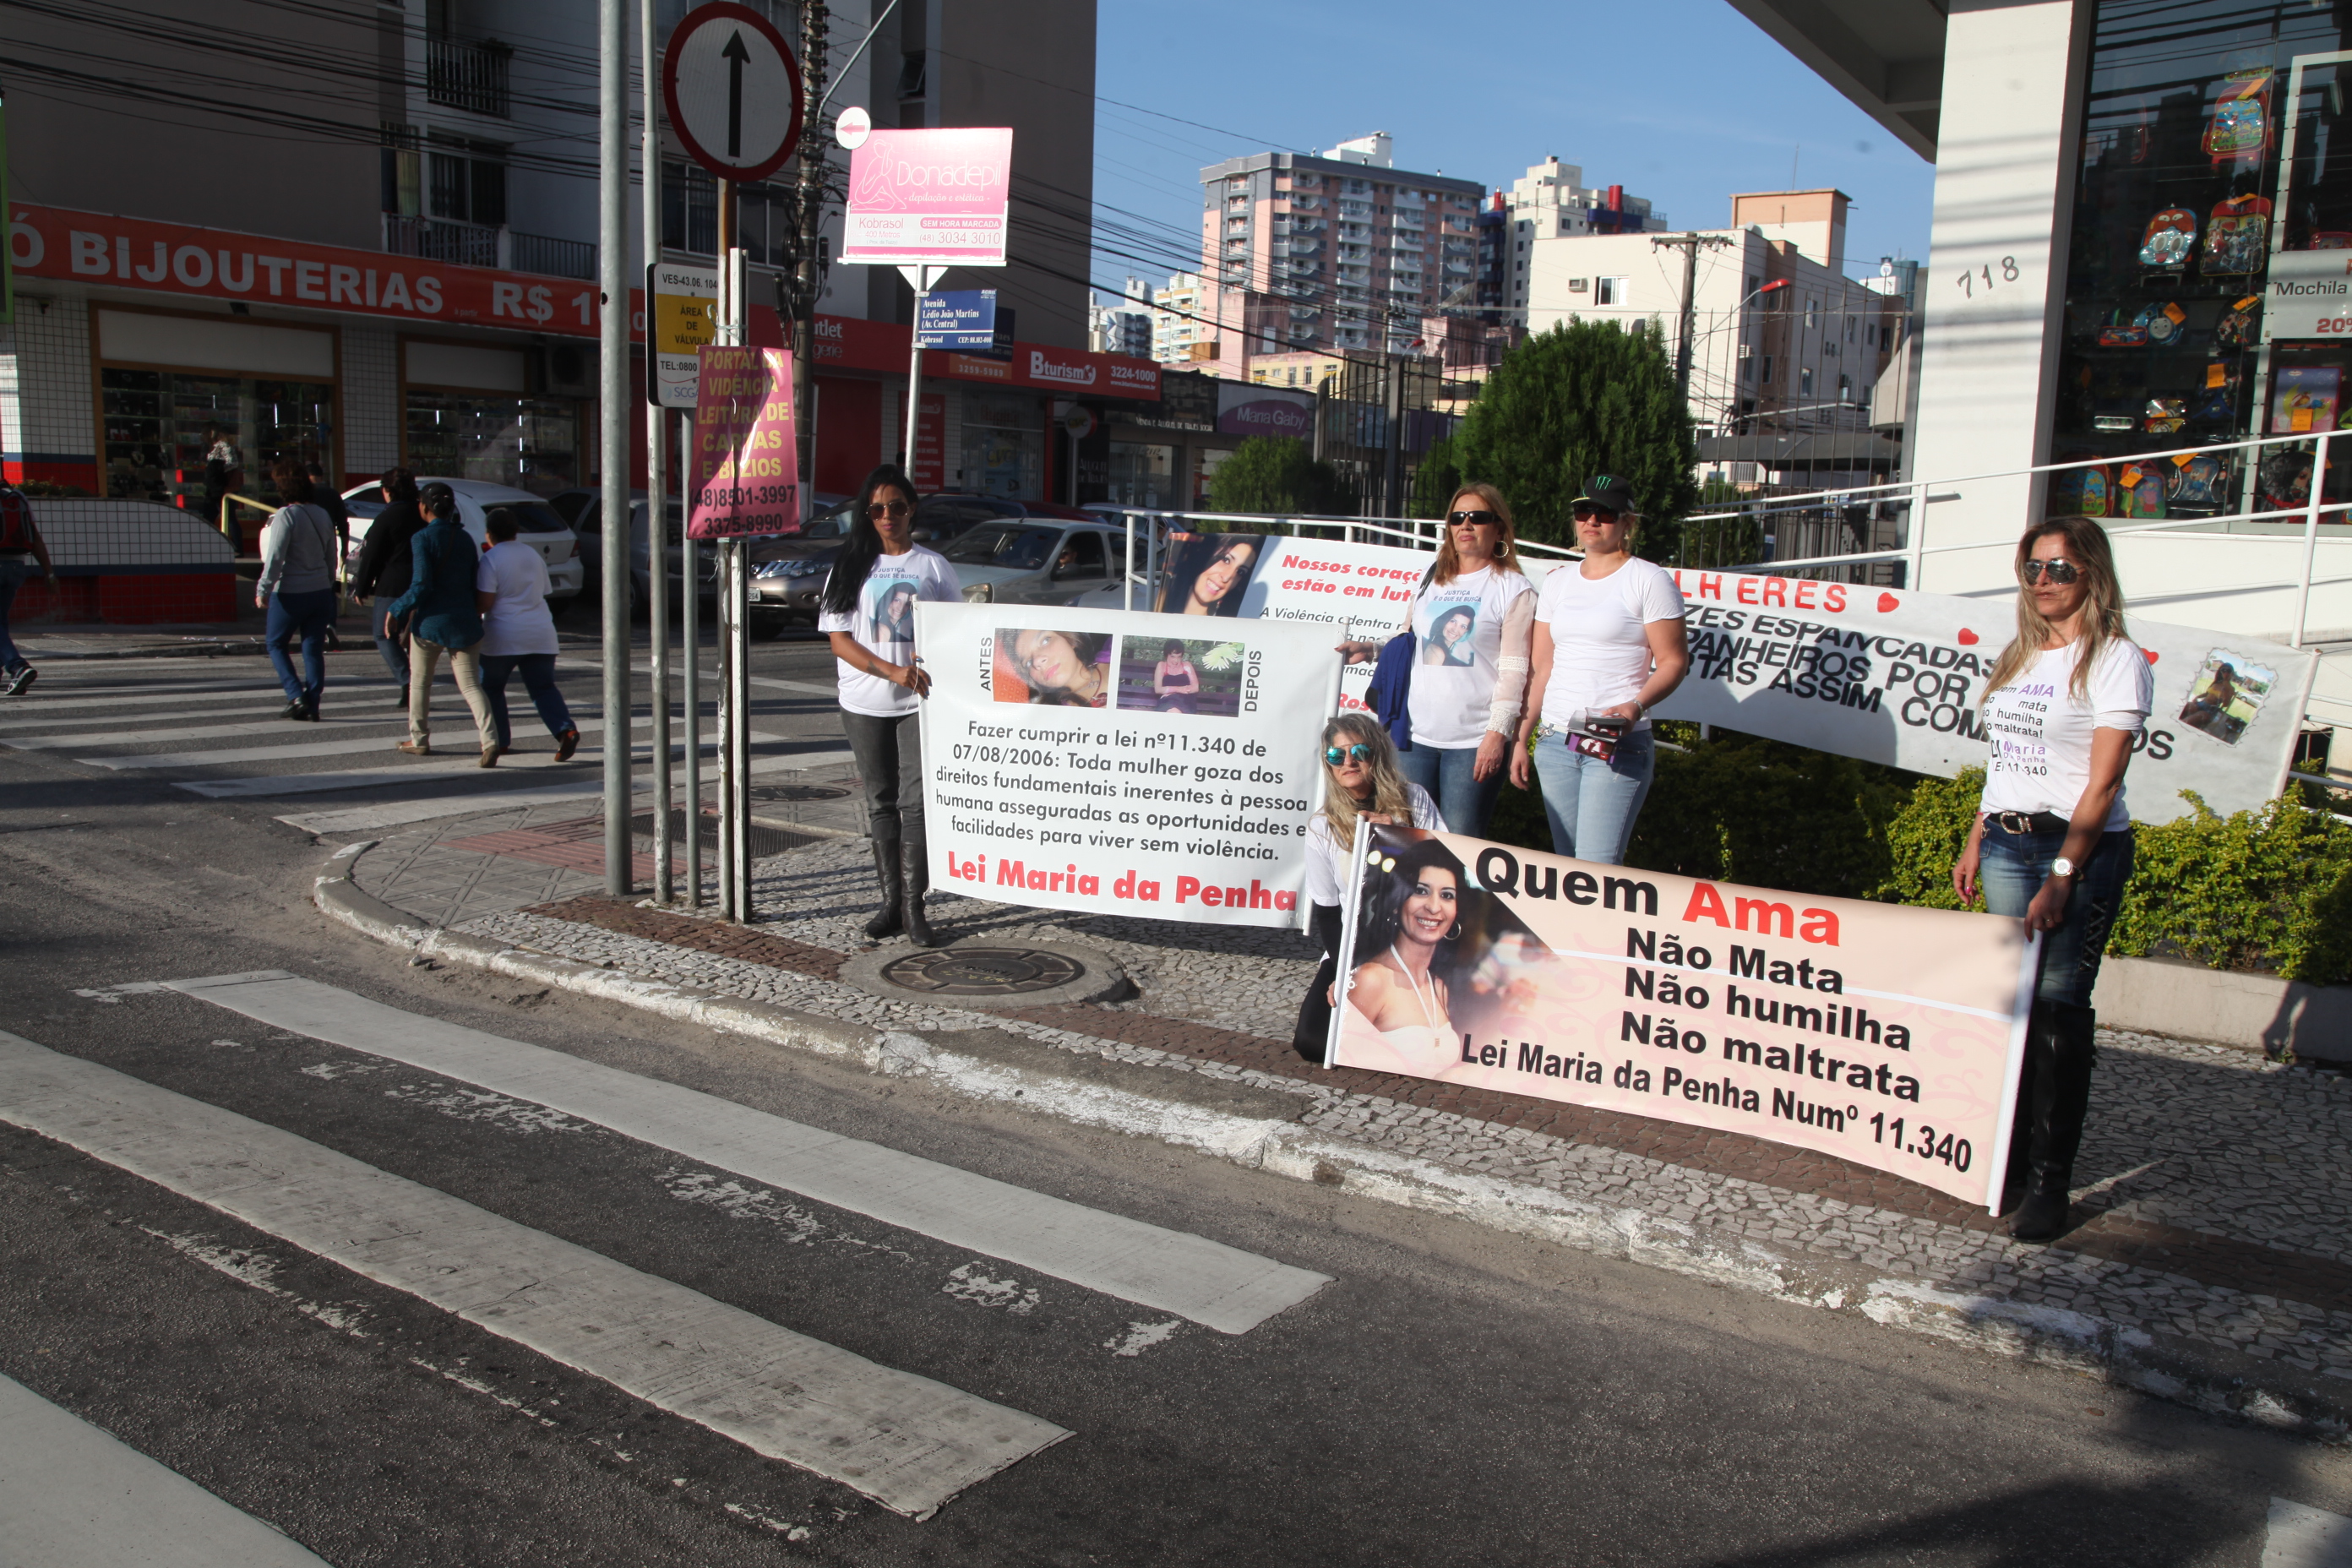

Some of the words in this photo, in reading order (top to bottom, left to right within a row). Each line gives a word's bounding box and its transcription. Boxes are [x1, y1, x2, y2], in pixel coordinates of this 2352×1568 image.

[897, 161, 1002, 191] Donadepil
[908, 192, 947, 204] depilação
[955, 192, 985, 202] estética
[859, 217, 904, 229] Kobrasol
[939, 220, 961, 228] HORA
[961, 220, 999, 228] MARCADA
[879, 230, 901, 238] Metros
[919, 234, 934, 244] (48)
[938, 231, 967, 244] 3034
[971, 231, 1001, 244] 3010
[70, 230, 444, 314] BIJOUTERIAS
[662, 274, 703, 288] VES-43.06.
[1957, 255, 2020, 299] 718
[2276, 280, 2348, 296] Mochila
[493, 280, 553, 325] R$
[680, 304, 703, 317] ÁREA
[923, 299, 945, 308] Avenida
[923, 309, 939, 318] Lédio
[940, 309, 954, 318] João
[955, 308, 979, 318] Martins
[686, 321, 698, 331] DE
[922, 319, 932, 329] (Av.
[934, 318, 958, 329] Central)
[675, 335, 710, 346] VÁLVULA
[661, 360, 698, 372] TEL:0800
[705, 351, 759, 370] PORTAL
[958, 364, 1004, 377] 3259-5989
[1110, 365, 1157, 383] 3224-1000
[709, 373, 779, 396] VIDÊNCIA
[698, 406, 761, 425] LEITURA
[766, 402, 789, 421] DE
[1272, 410, 1305, 430] Gaby
[702, 430, 782, 452] CARTAS
[702, 460, 713, 479] E
[705, 513, 783, 536] 3375-8990
[1282, 554, 1352, 574] Nossos
[1282, 576, 1337, 596] estão
[1343, 585, 1375, 598] em
[1260, 607, 1270, 617] A
[1274, 607, 1335, 625] Violência
[978, 635, 994, 692] ANTES
[1244, 649, 1262, 713] DEPOIS
[1767, 667, 1884, 713] ASSIM
[1885, 661, 1971, 708] POR
[2018, 683, 2055, 698] AMA
[2018, 700, 2048, 712] mata
[1997, 708, 2043, 727] humilha
[968, 720, 1014, 740] Fazer
[1018, 726, 1091, 749] cumprir
[1096, 732, 1108, 745] a
[1114, 729, 1138, 749] lei
[1144, 732, 1236, 755] nº11.340
[1242, 738, 1267, 758] de
[1995, 723, 2043, 739] maltrata!
[2003, 740, 2046, 755] Maria
[952, 743, 1060, 770] 07/08/2006:
[1067, 751, 1112, 772] Toda
[1118, 757, 1189, 779] mulher
[1194, 764, 1242, 785] goza
[1249, 764, 1284, 785] dos
[935, 765, 988, 787] direitos
[994, 770, 1118, 798] fundamentais
[1124, 784, 1214, 806] inerentes
[1220, 786, 1233, 807] à
[1239, 792, 1309, 814] pessoa
[935, 789, 994, 813] humana
[999, 798, 1113, 824] asseguradas
[1119, 809, 1140, 825] as
[1146, 808, 1299, 837] oportunidades
[950, 815, 1035, 842] facilidades
[1039, 829, 1082, 855] para
[1088, 830, 1135, 850] viver
[1140, 837, 1180, 854] sem
[1186, 834, 1280, 861] violência.
[948, 851, 987, 884] Lei
[996, 858, 1100, 897] Maria
[1113, 870, 1161, 902] da
[1175, 874, 1298, 912] Penha
[1475, 847, 1659, 917] Quem
[1681, 880, 1842, 946] Ama
[1626, 927, 1712, 970] Não
[1729, 945, 1844, 996] Mata
[1624, 967, 1711, 1010] Não
[1727, 981, 1913, 1053] humilha
[1620, 1011, 1707, 1055] Não
[1723, 1035, 1922, 1103] maltrata
[1462, 1033, 1509, 1070] Lei
[1516, 1041, 1604, 1086] Maria
[1614, 1060, 1652, 1094] da
[1662, 1072, 1761, 1115] Penha
[1772, 1089, 1860, 1135] Numº
[1869, 1111, 1974, 1174] 11.340
